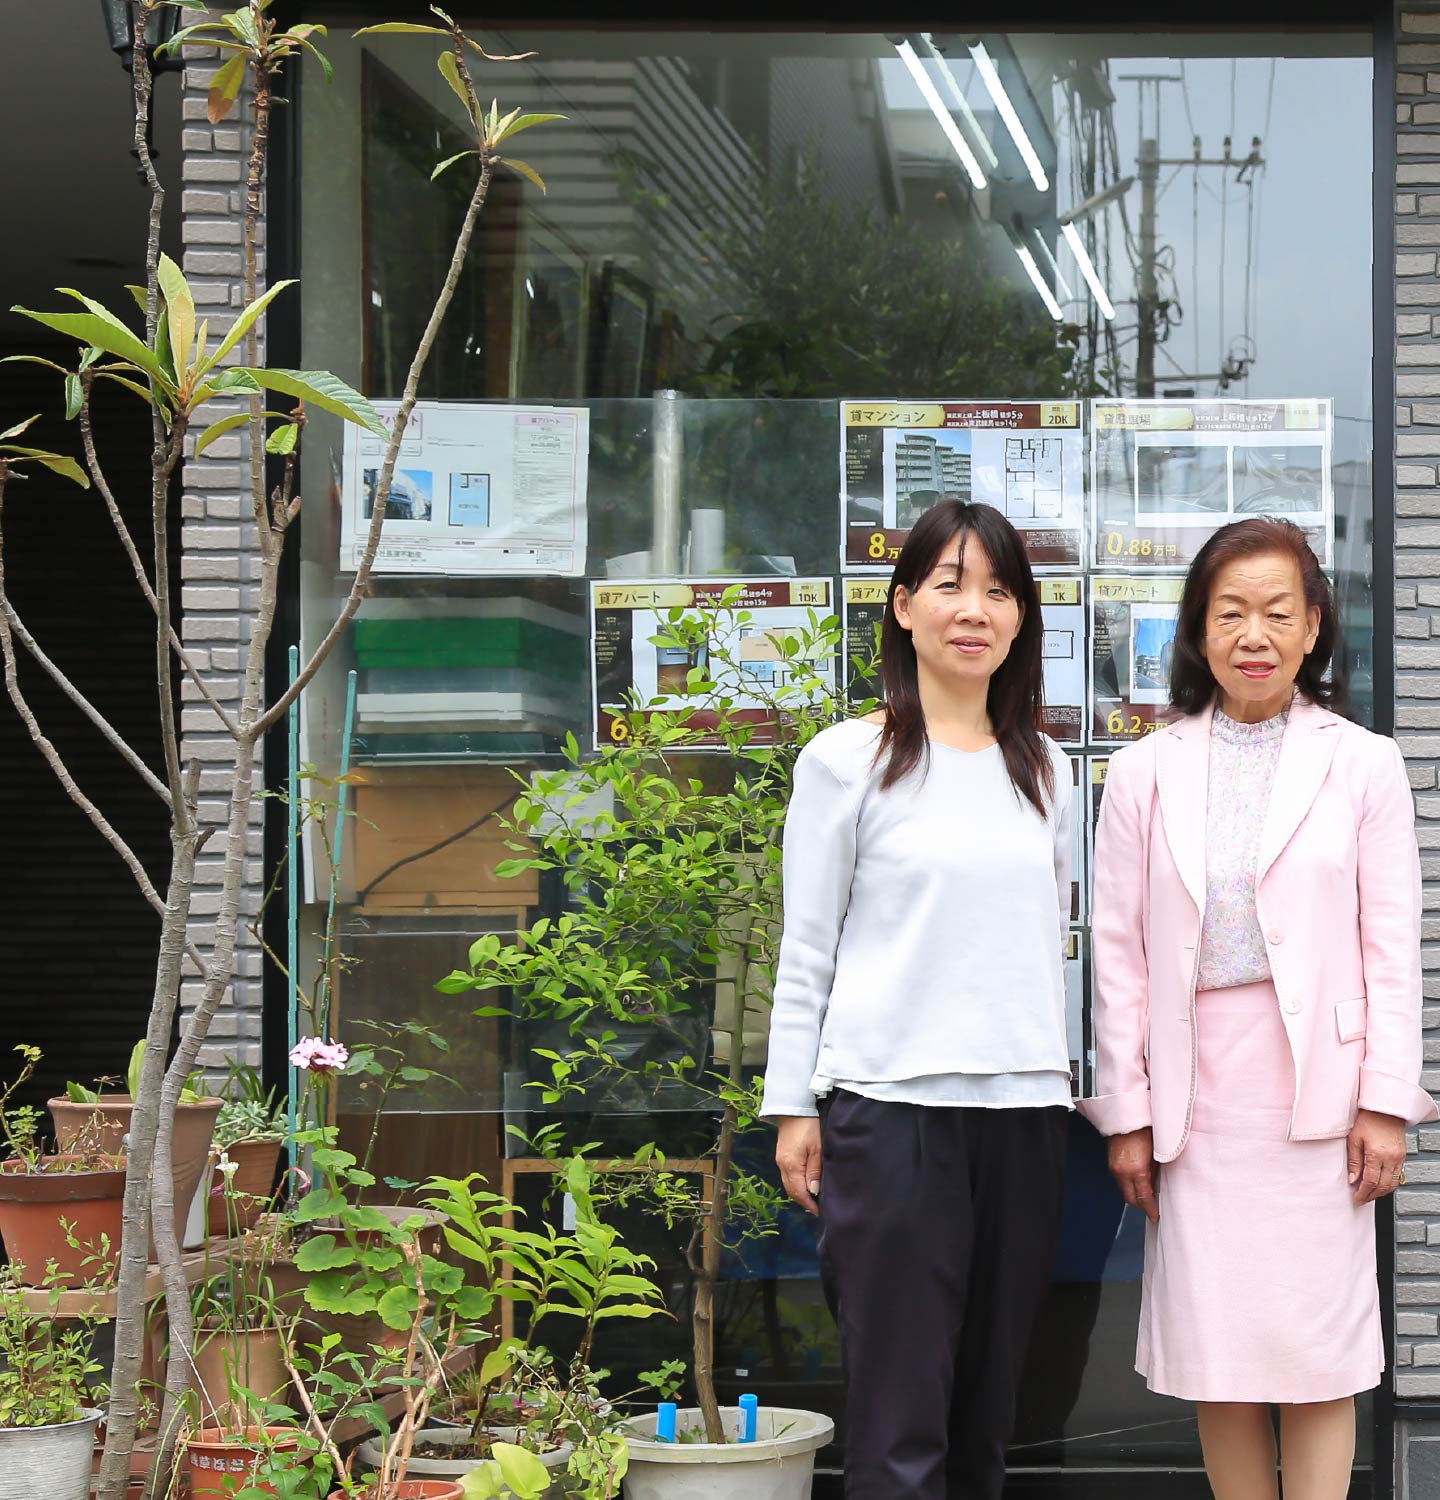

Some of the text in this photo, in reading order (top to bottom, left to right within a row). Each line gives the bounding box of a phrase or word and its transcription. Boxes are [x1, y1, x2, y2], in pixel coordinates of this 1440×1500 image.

[849, 409, 926, 423] 貸マンション
[1048, 415, 1069, 425] 2DK
[599, 591, 661, 605] 貸アパート
[798, 593, 818, 603] 1DK
[1053, 592, 1066, 601] 1K
